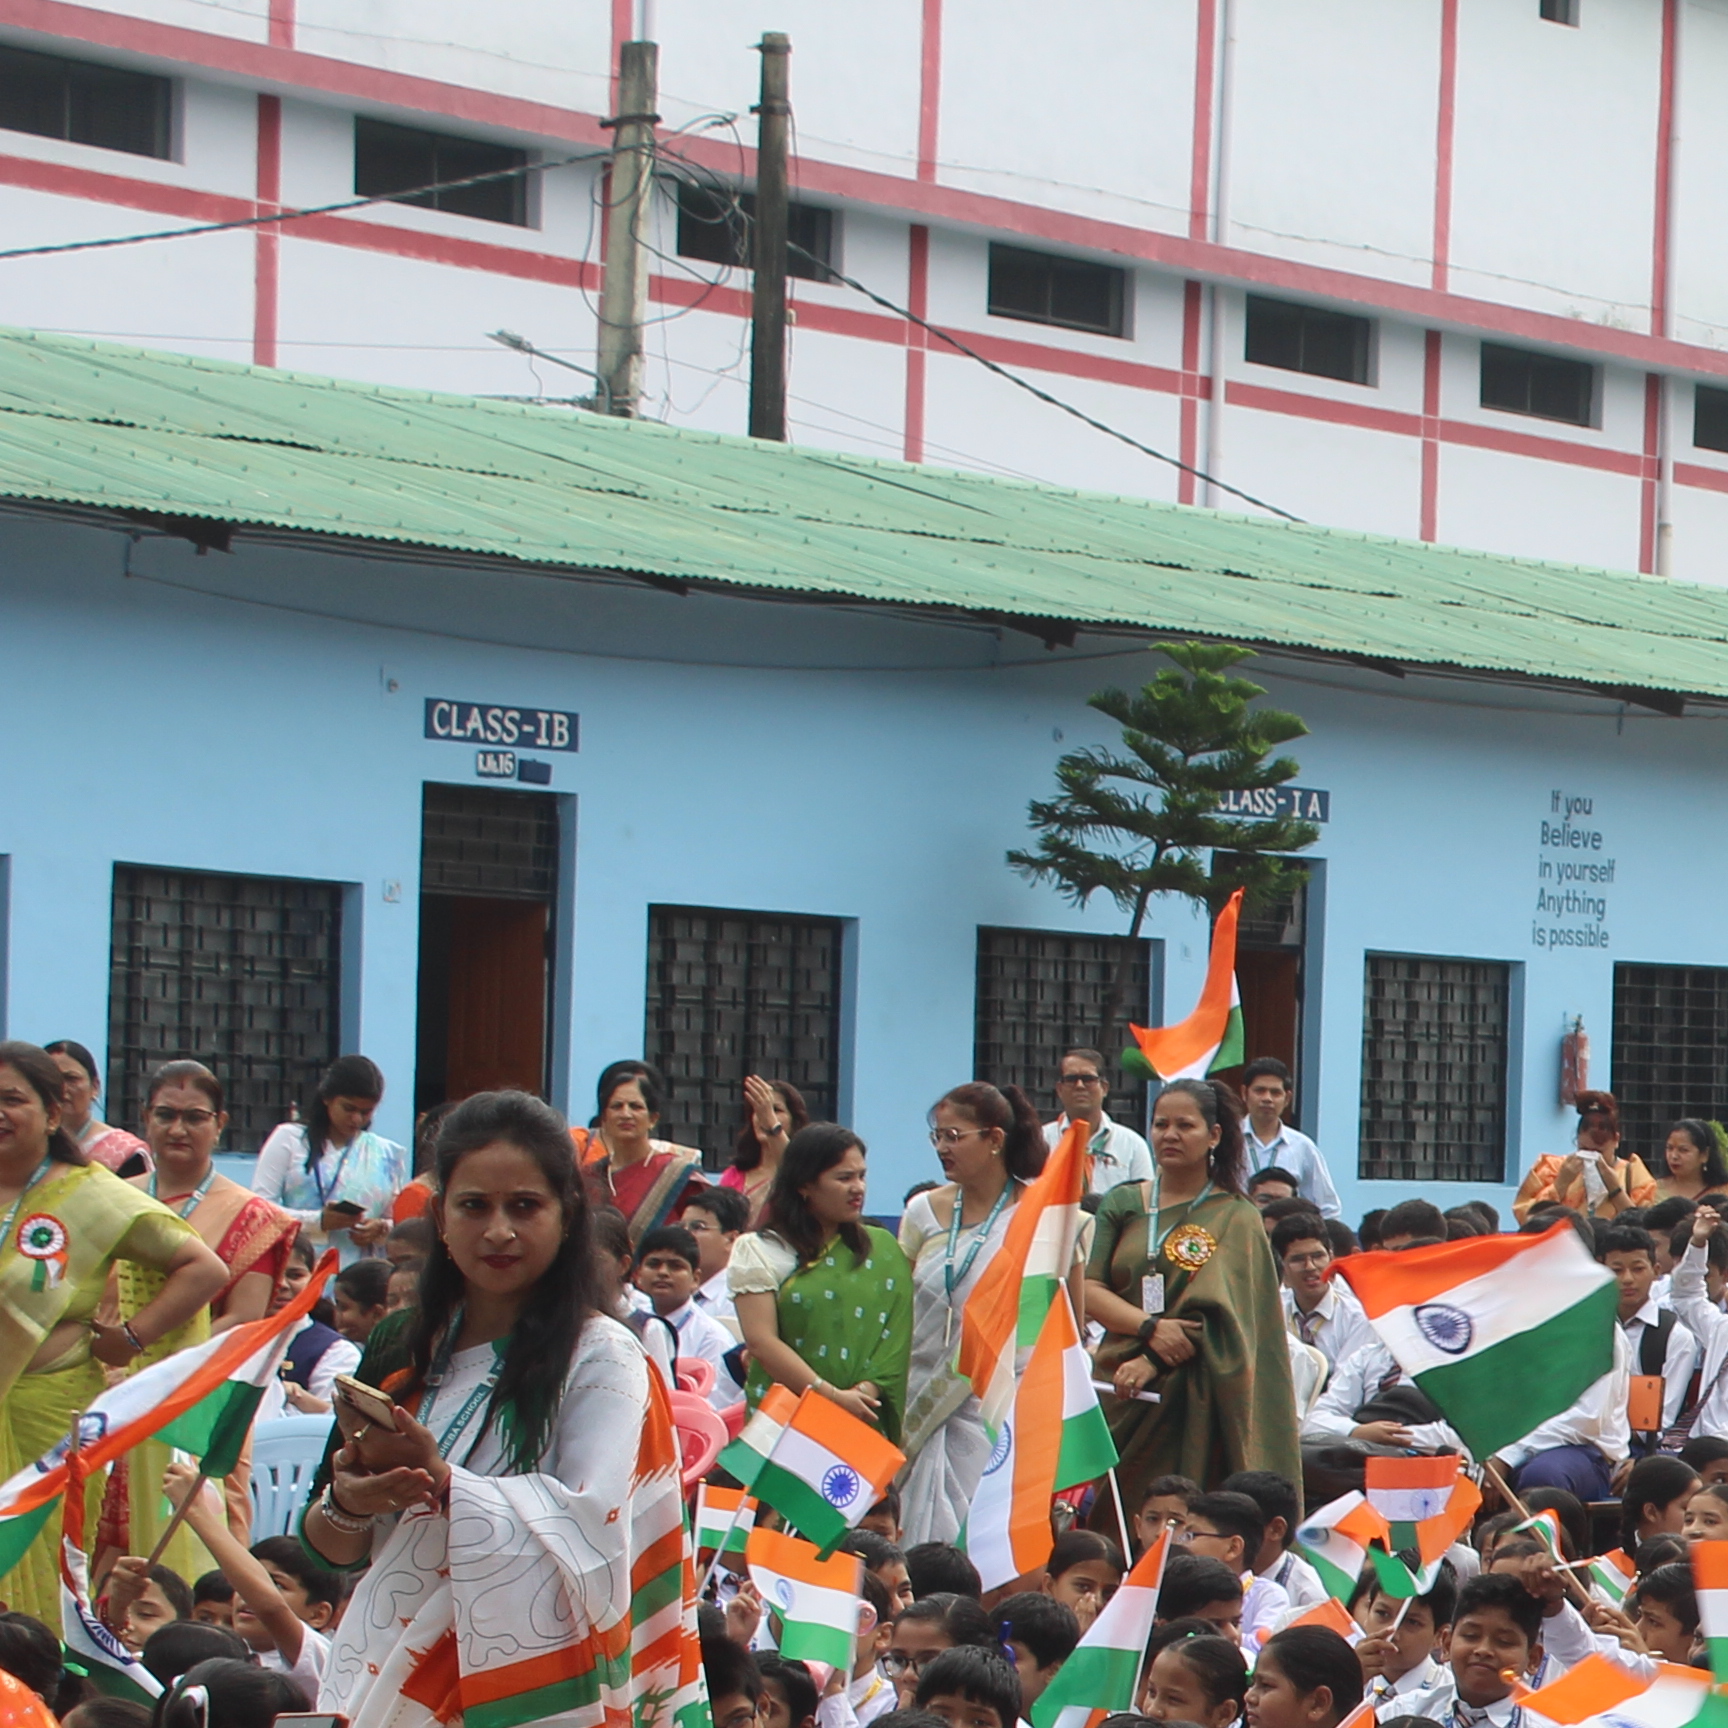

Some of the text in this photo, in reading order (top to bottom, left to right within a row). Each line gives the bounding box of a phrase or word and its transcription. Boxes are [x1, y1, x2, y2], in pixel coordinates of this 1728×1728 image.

[433, 702, 570, 748] CLASS-IB
[1551, 789, 1593, 820] If you
[1541, 821, 1603, 851] Believe
[1539, 854, 1616, 885] in yourself
[1536, 887, 1606, 921] Anything
[1532, 920, 1610, 951] is possible
[459, 1390, 486, 1428] SCHOOL
